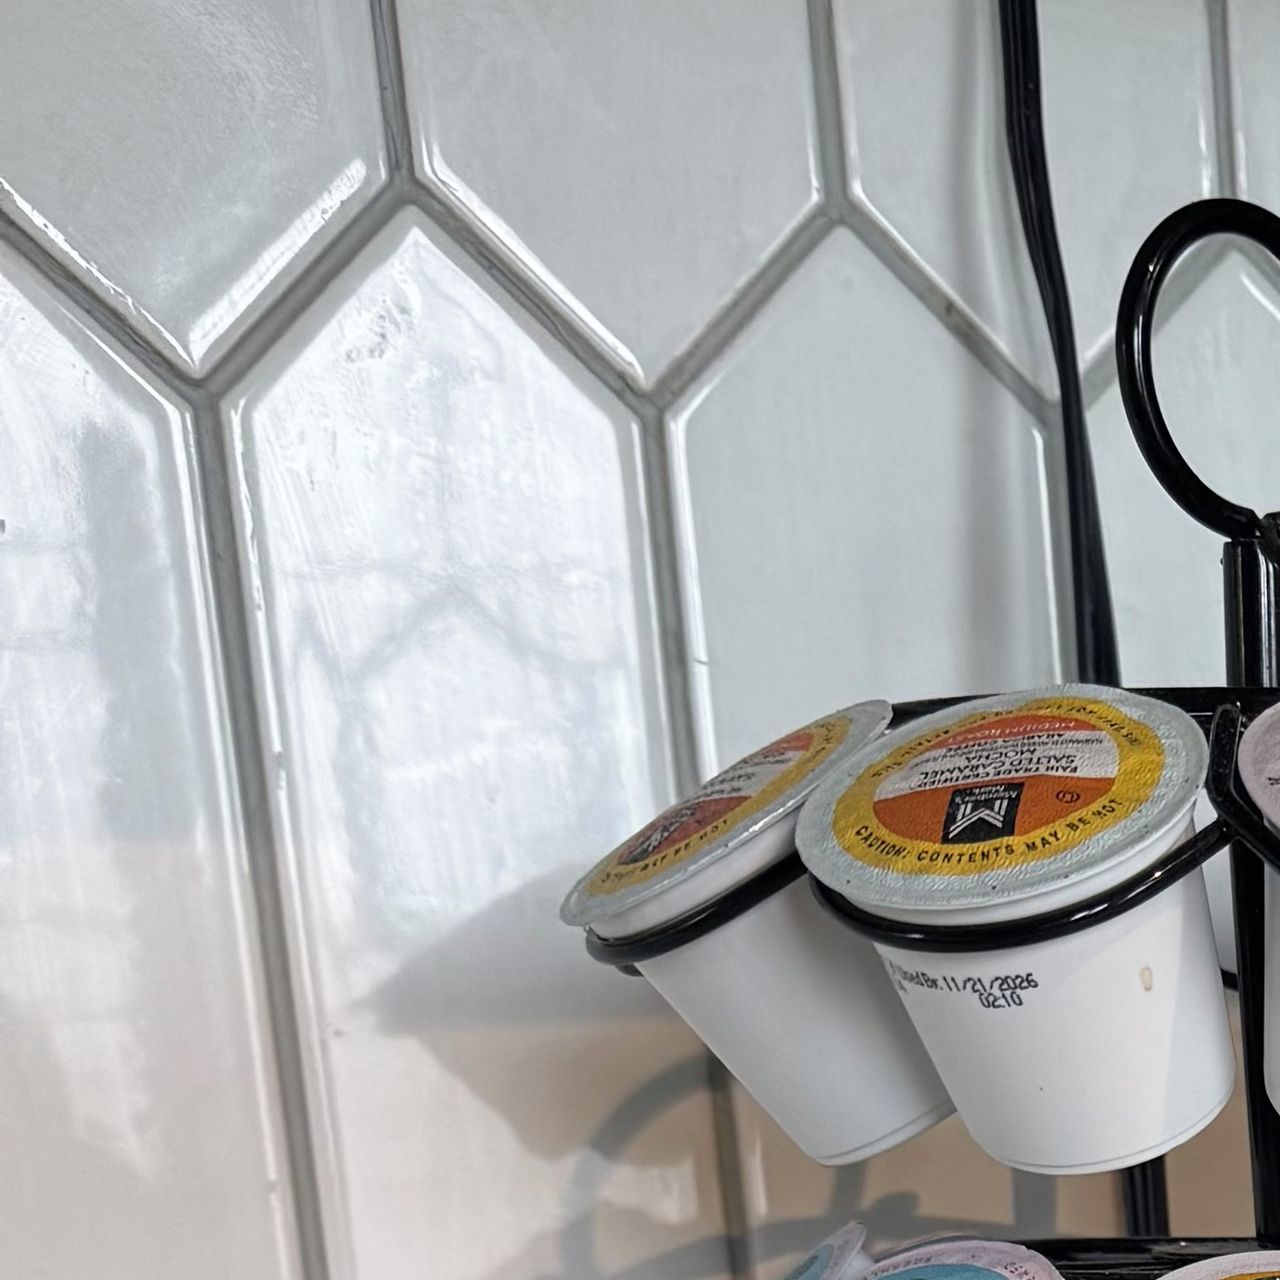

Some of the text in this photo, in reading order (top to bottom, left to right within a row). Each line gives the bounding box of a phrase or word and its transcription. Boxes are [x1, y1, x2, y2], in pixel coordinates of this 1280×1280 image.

[963, 747, 1037, 764] MOCHA
[918, 760, 1008, 781] CARAMEL
[916, 844, 1015, 864] CONTENTS
[1027, 828, 1061, 852] MAY
[1067, 815, 1090, 833] BE
[1091, 798, 1124, 823] HOT
[943, 972, 1040, 993] 11/21/2026
